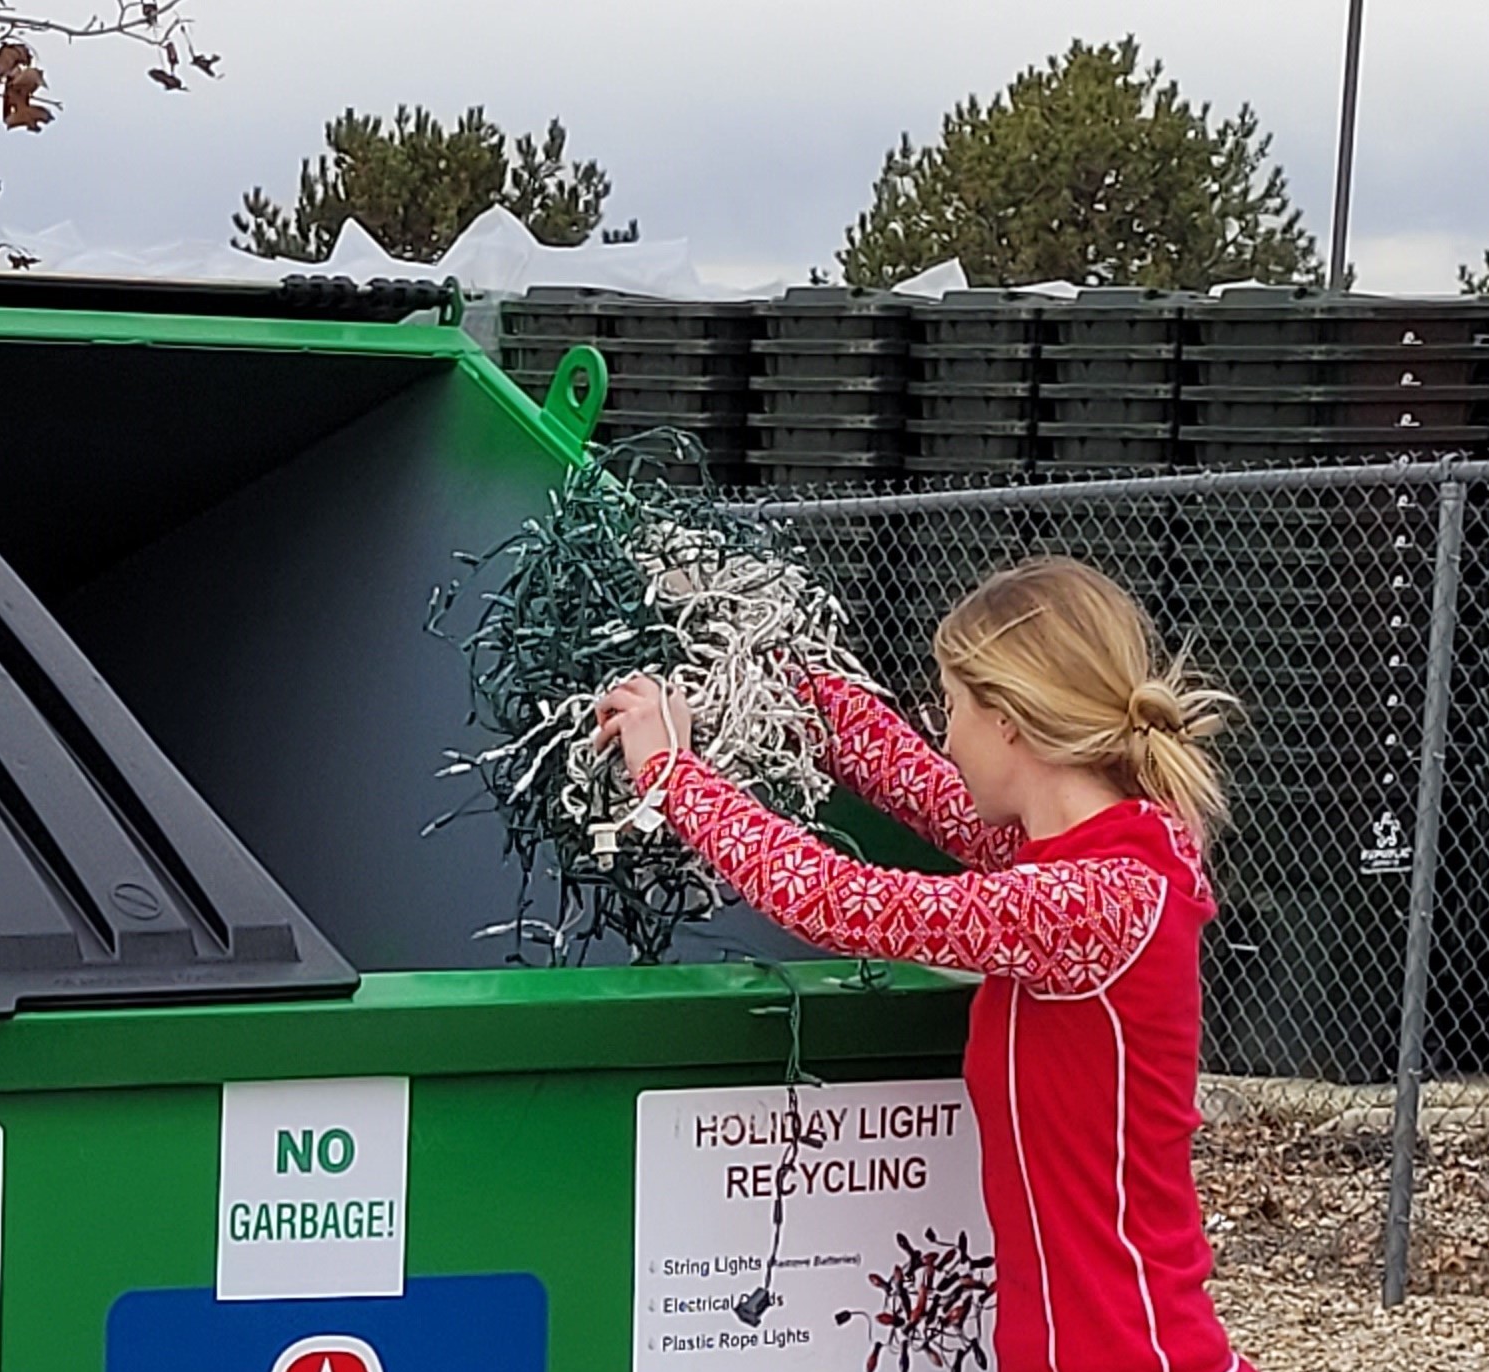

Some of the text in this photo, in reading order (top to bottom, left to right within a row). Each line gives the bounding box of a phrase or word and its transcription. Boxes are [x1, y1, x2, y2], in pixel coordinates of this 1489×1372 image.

[859, 1103, 961, 1141] LIGHT
[277, 1128, 356, 1174] NO
[726, 1157, 927, 1199] RECYCLING
[229, 1200, 396, 1242] GARBAGE!
[663, 1259, 710, 1277] String
[714, 1257, 762, 1275] Lights
[663, 1297, 733, 1314] Electrical
[662, 1329, 810, 1352] Plastic Rope Lights
